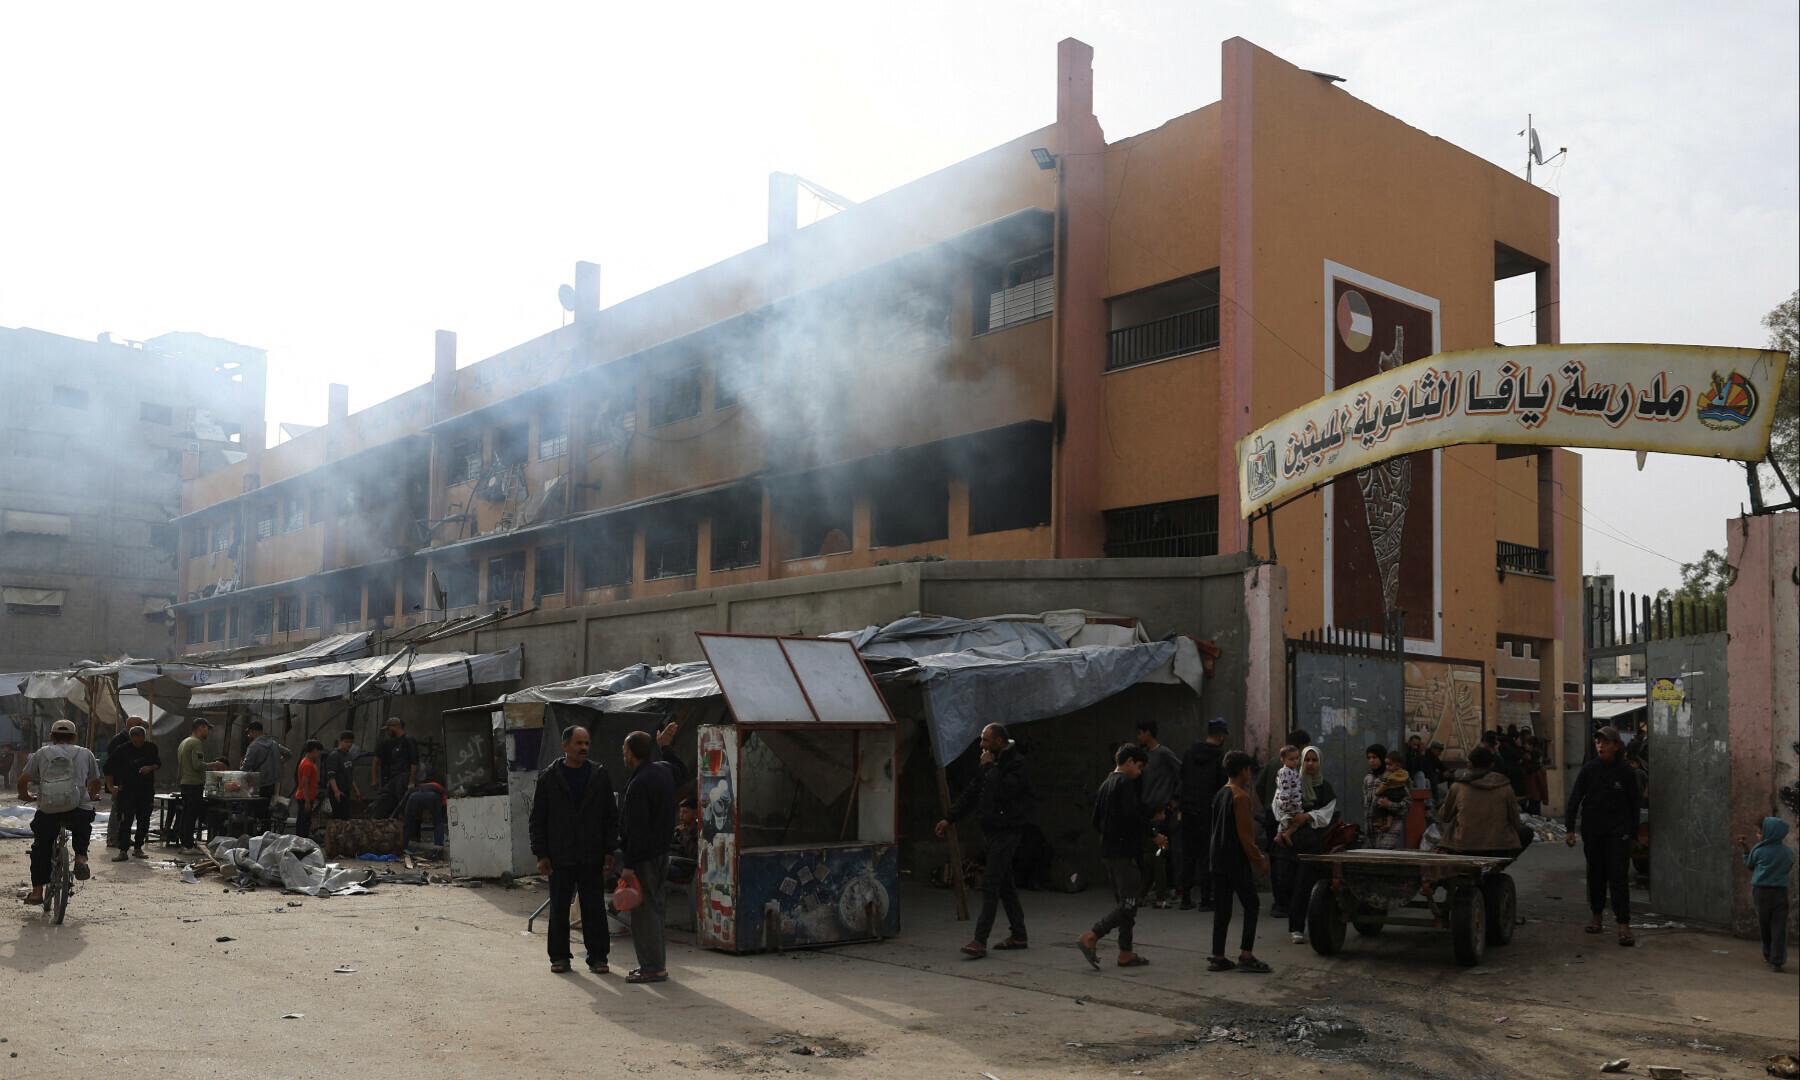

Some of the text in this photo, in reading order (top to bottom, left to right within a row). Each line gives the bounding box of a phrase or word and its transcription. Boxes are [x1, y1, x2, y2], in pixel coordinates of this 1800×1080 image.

[1282, 360, 1690, 479] مدرسة يافا الثانوية للبنين
